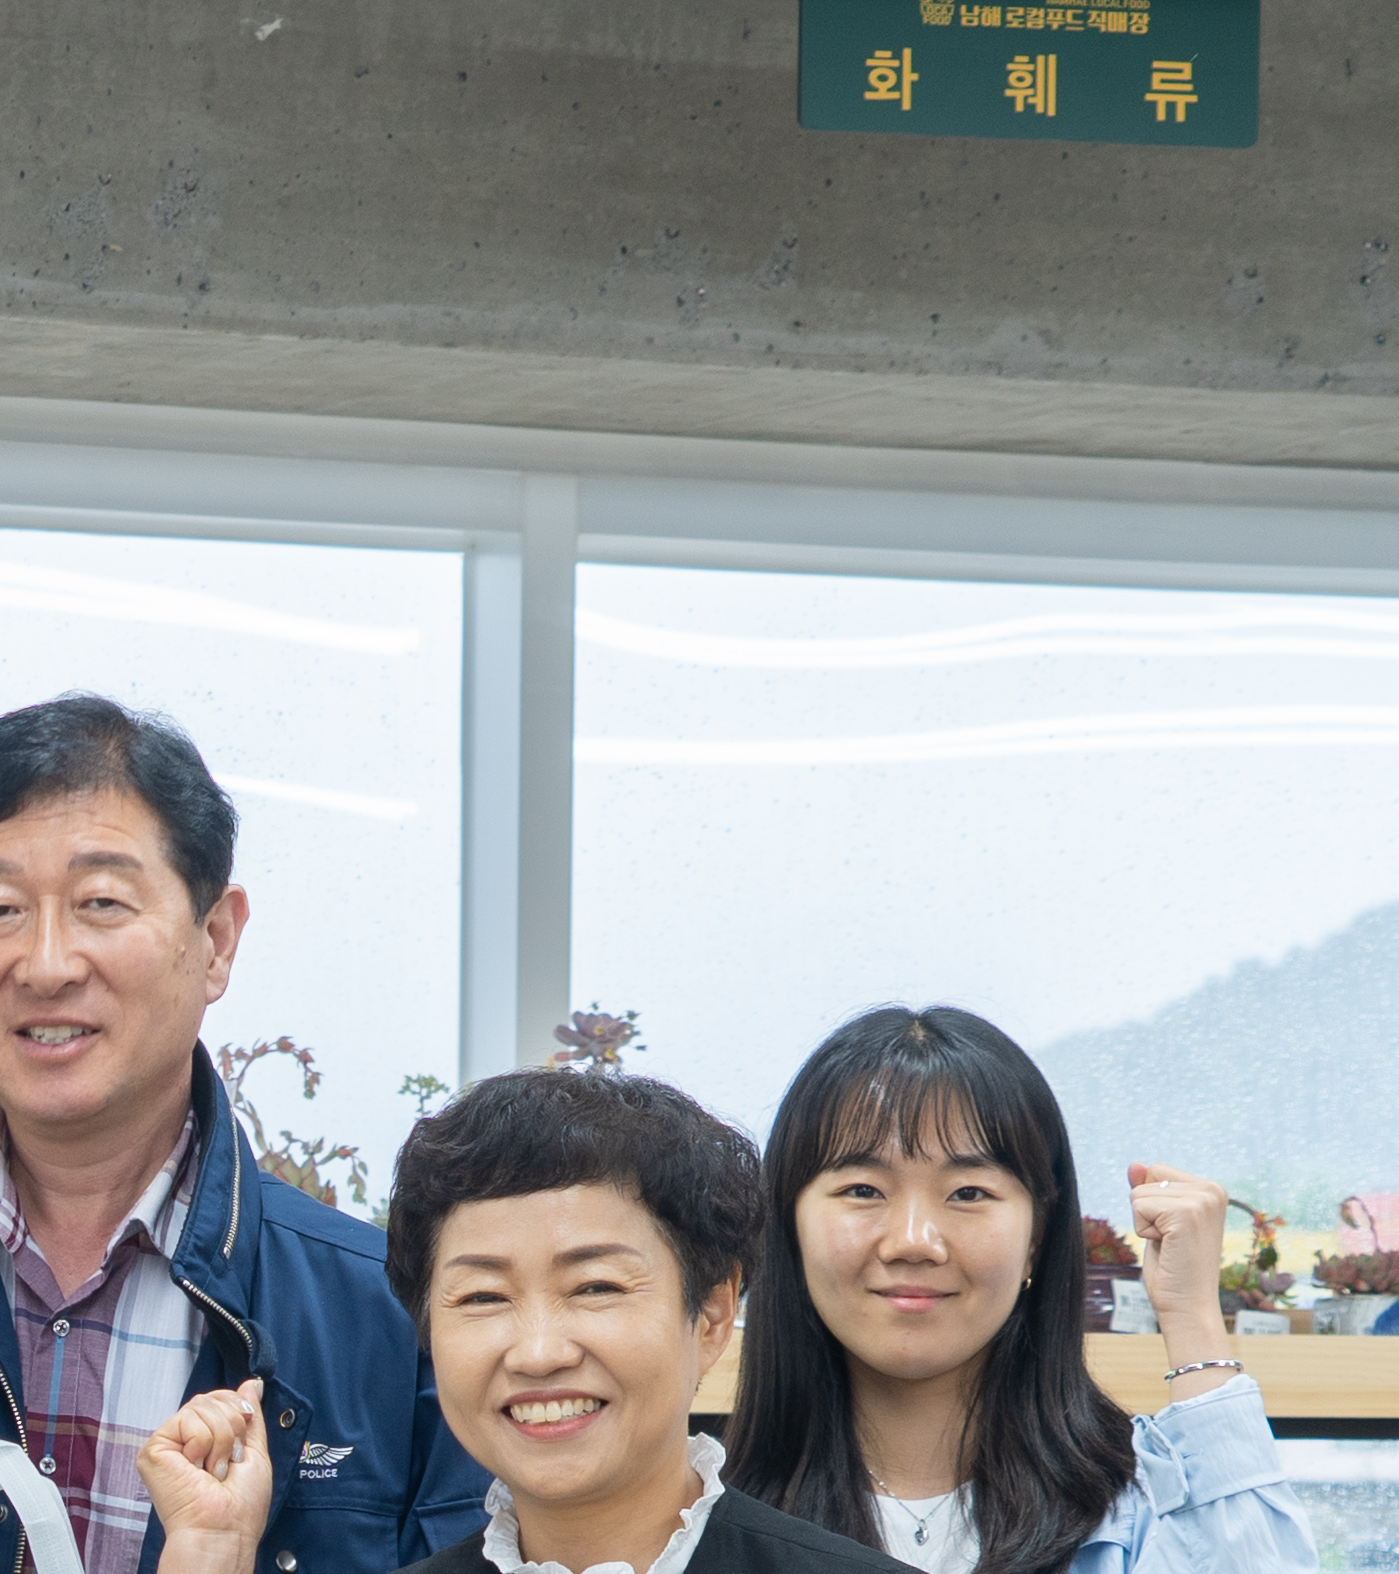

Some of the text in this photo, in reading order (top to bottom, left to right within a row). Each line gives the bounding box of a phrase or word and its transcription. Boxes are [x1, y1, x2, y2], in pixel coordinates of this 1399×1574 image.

[960, 5, 1151, 35] 남해 로컬푸드 직매장
[864, 47, 1199, 122] 화 훼 류
[299, 1468, 338, 1479] POLICE
